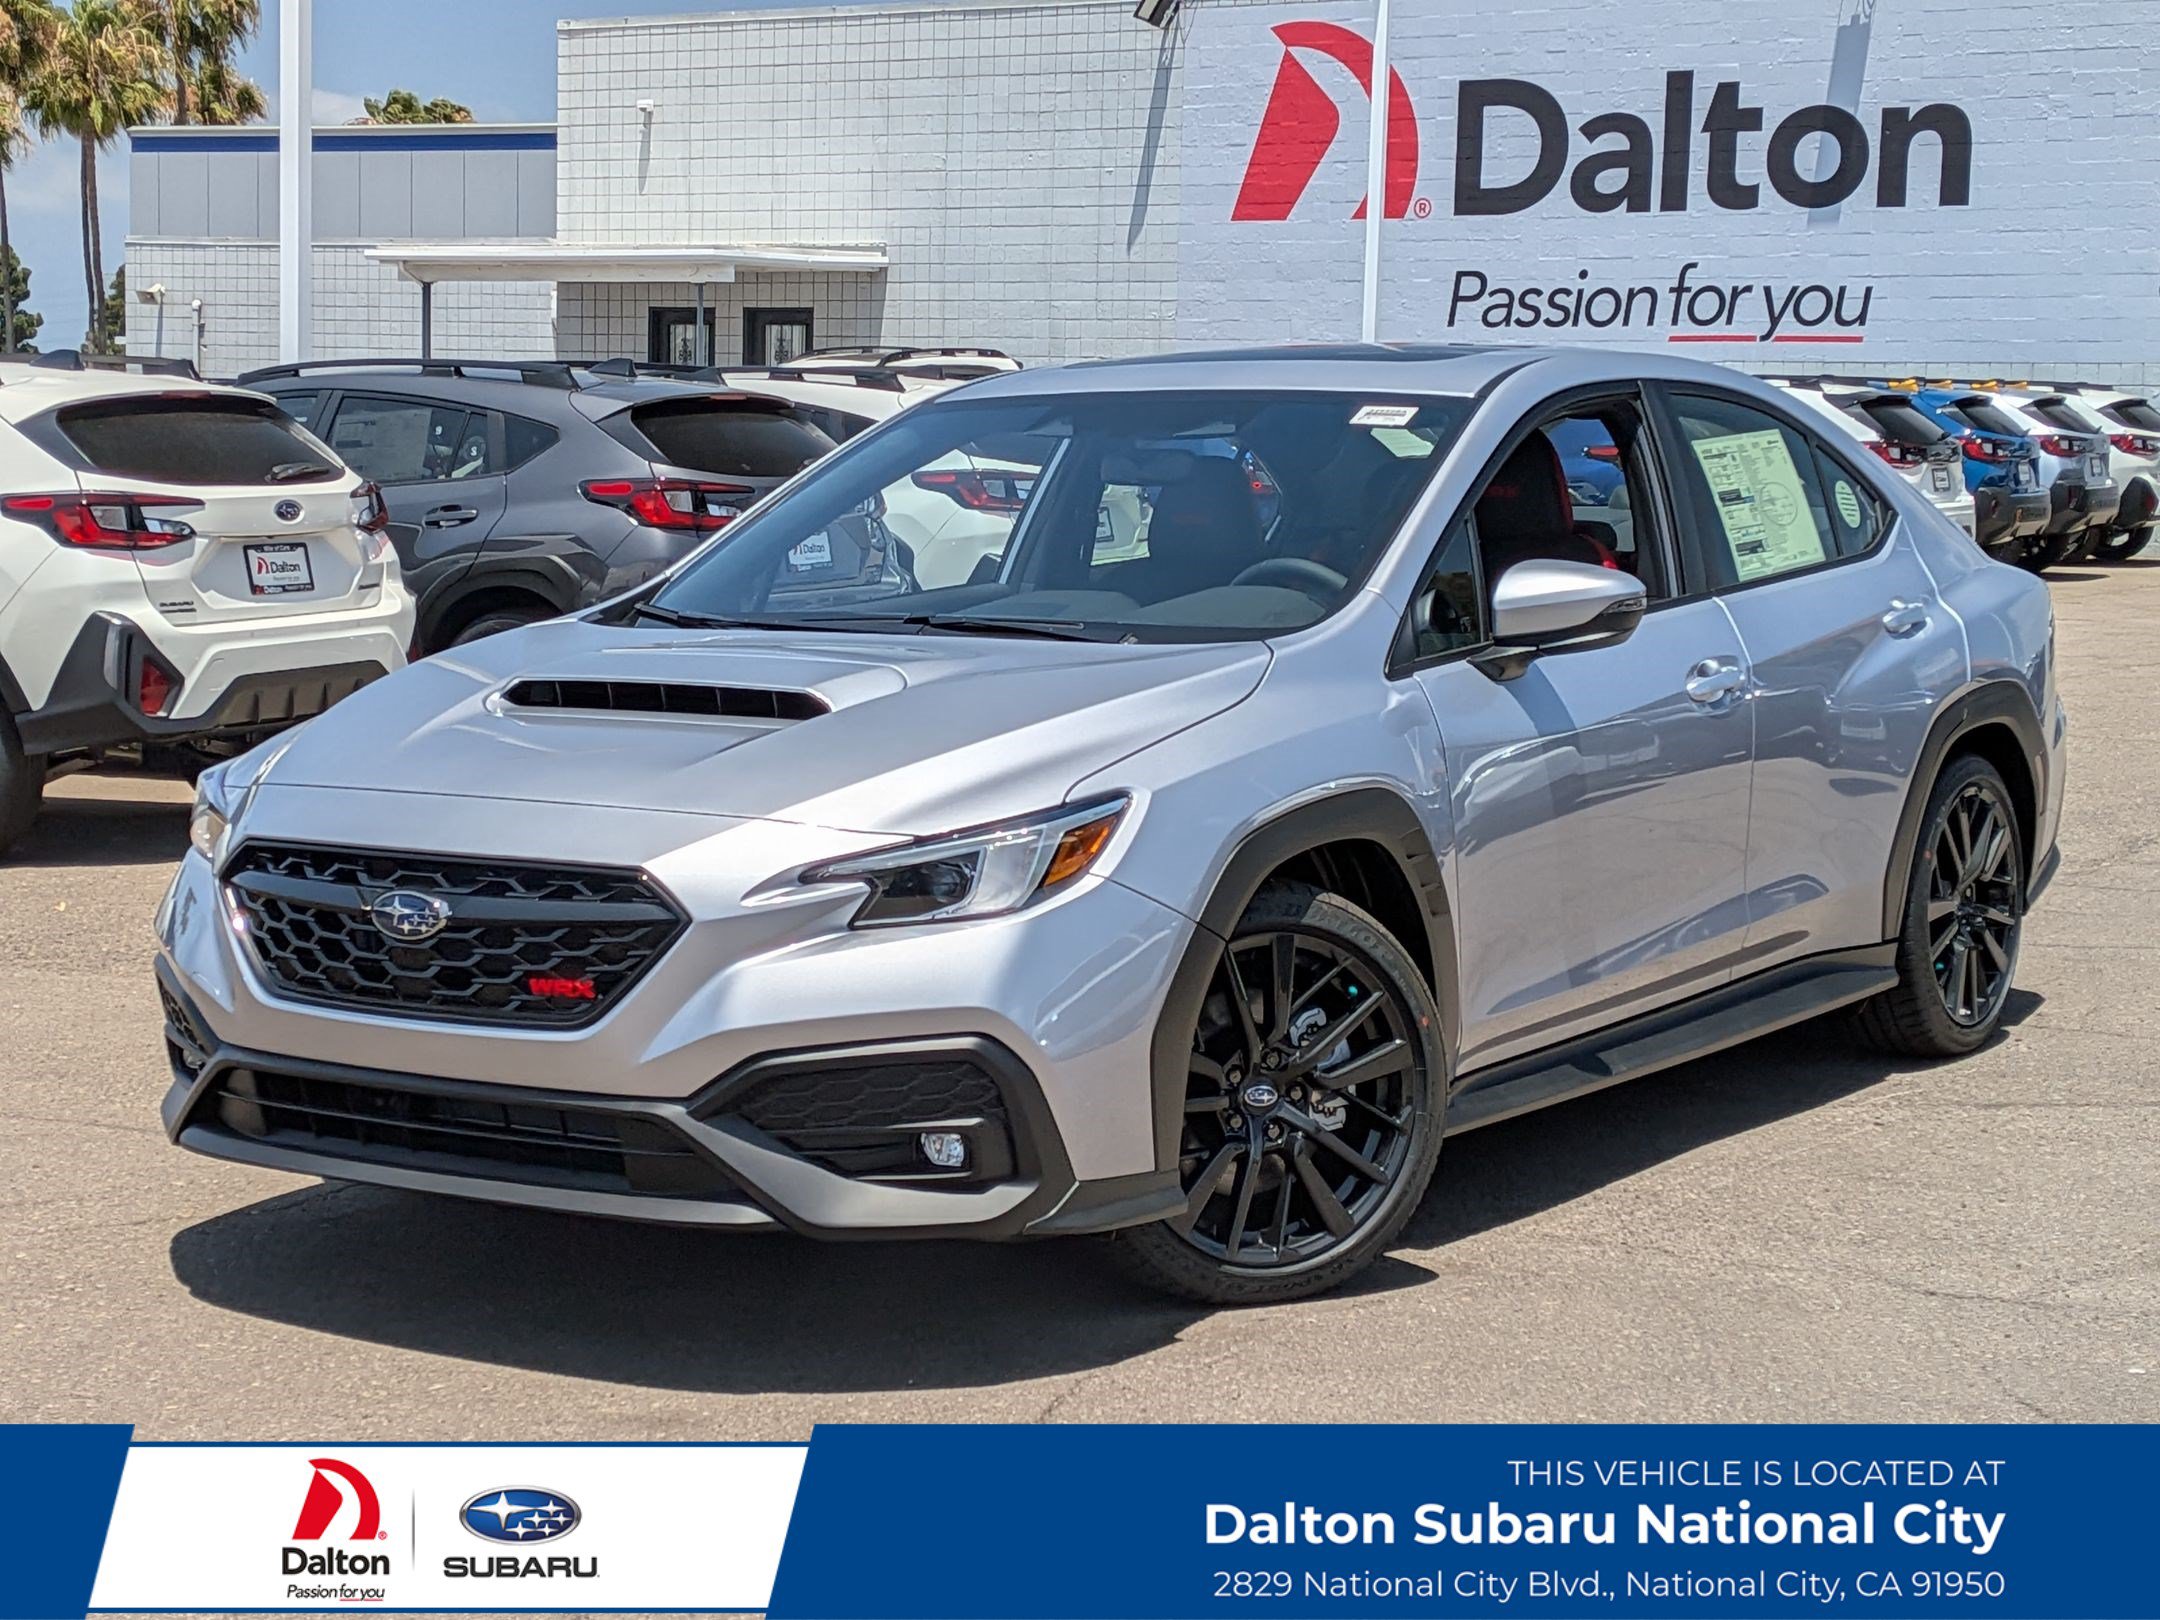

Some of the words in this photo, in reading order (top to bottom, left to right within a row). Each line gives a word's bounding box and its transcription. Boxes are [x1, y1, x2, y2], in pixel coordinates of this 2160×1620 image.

[1454, 70, 1972, 216] Dalton
[1447, 269, 1658, 328] Passion
[1669, 262, 1753, 327] for
[1759, 285, 1873, 342] you
[269, 561, 302, 574] Dalton
[528, 978, 596, 999] WRX
